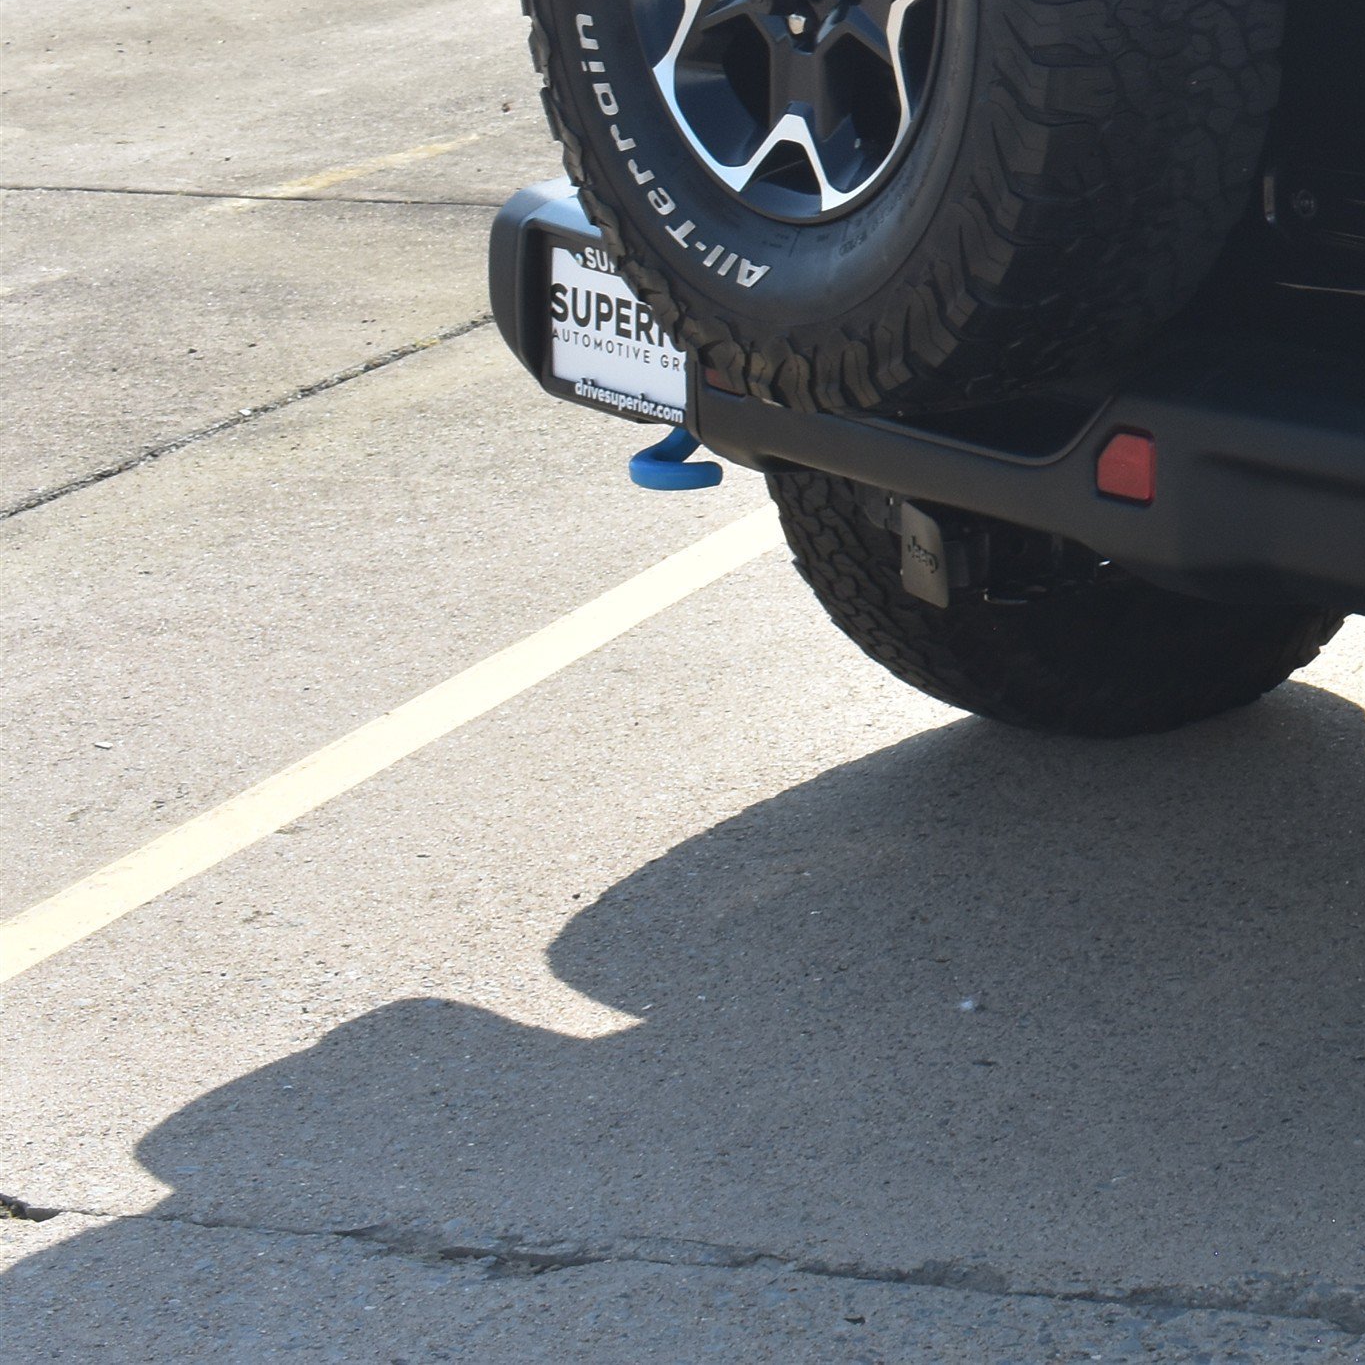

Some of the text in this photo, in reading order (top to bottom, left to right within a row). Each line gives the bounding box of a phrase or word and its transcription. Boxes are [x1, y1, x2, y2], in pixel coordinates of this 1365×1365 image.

[576, 13, 770, 288] All-Terrain
[552, 326, 651, 364] AUTOMOTIVE
[575, 380, 684, 423] drivesuperior.com
